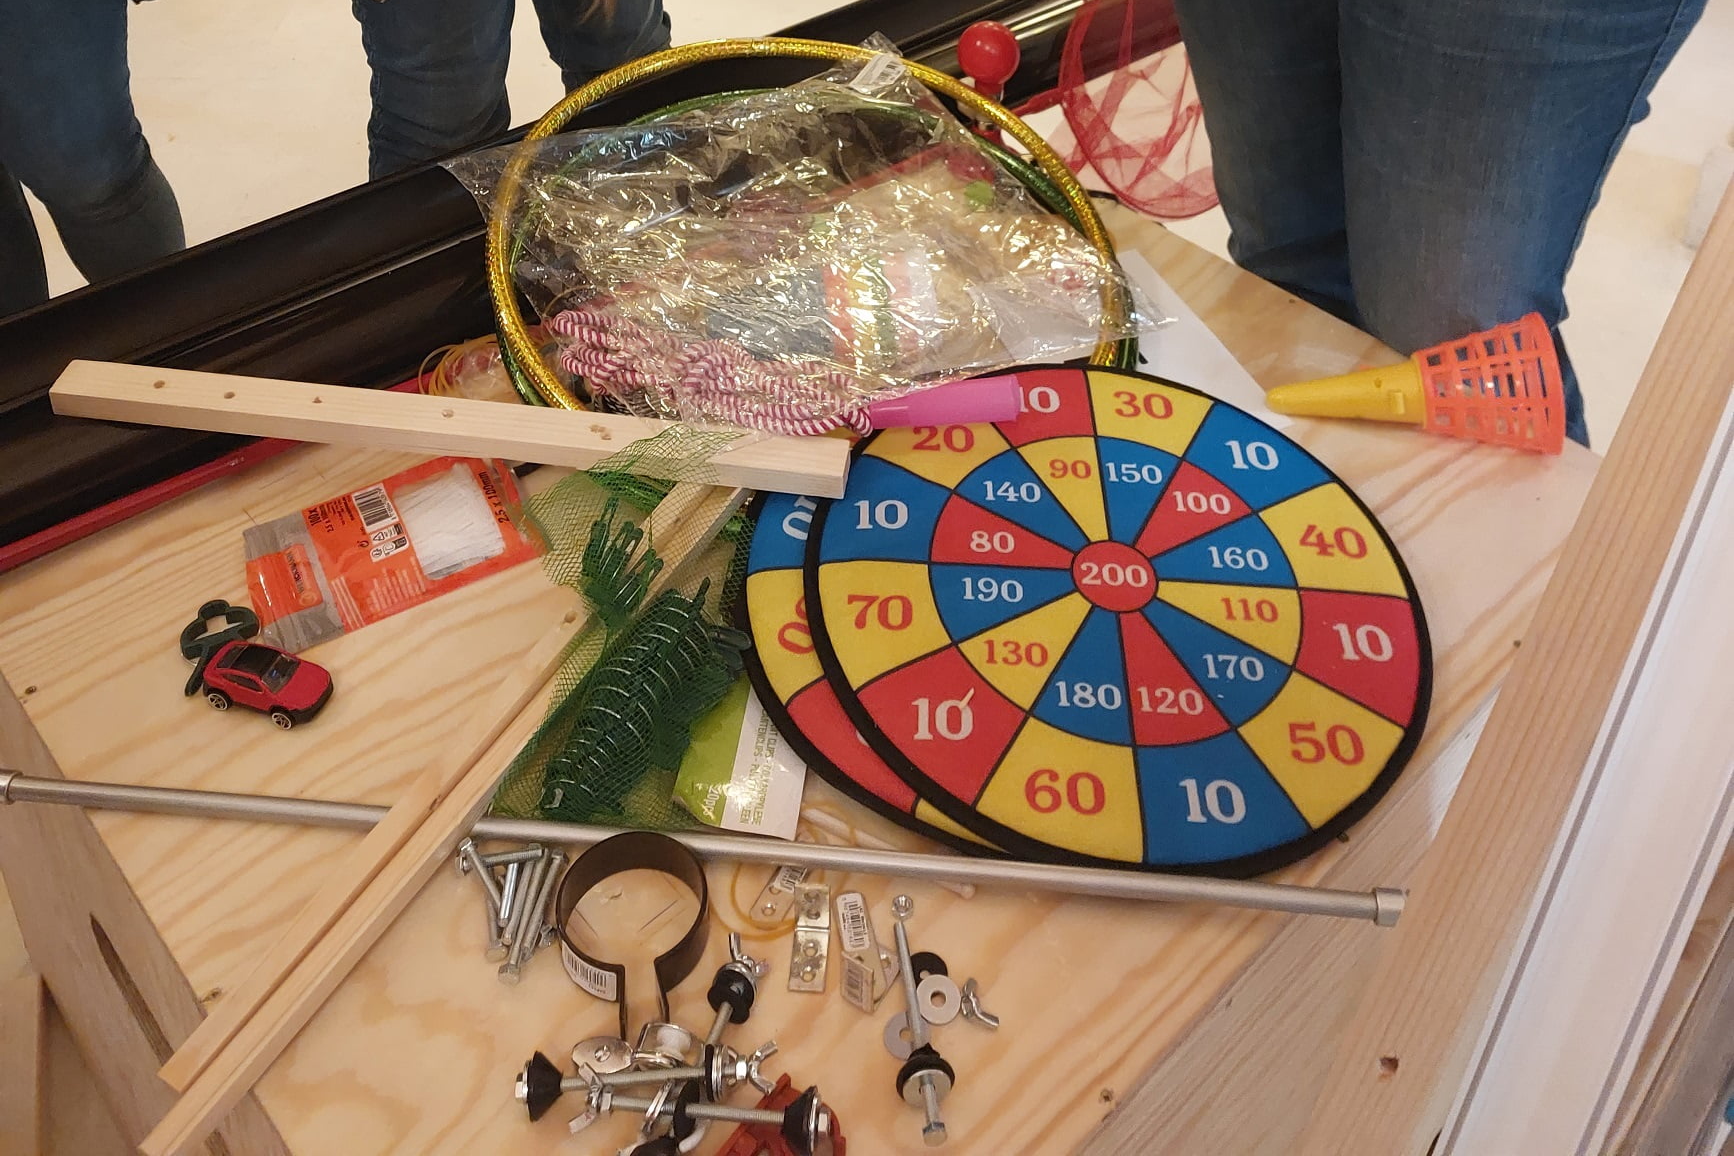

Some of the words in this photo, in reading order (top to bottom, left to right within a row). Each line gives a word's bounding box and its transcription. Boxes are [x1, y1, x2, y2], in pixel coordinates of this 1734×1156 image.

[1115, 393, 1173, 419] 30
[912, 424, 975, 453] 20
[1224, 442, 1279, 470] 10
[1050, 461, 1092, 479] 90
[1107, 464, 1163, 484] 150
[478, 471, 497, 500] 100mm
[983, 482, 1041, 503] 140
[494, 509, 510, 524] 2.5
[856, 501, 908, 529] 10
[1173, 493, 1231, 515] 100
[969, 533, 1015, 553] 80
[1300, 526, 1368, 559] 40
[1209, 548, 1268, 571] 160
[1080, 564, 1148, 587] 200
[962, 579, 1024, 603] 190
[846, 596, 913, 631] 70
[1220, 599, 1279, 623] 110
[984, 641, 1049, 668] 130
[1332, 625, 1393, 661] 10
[1204, 656, 1264, 681] 170
[1056, 683, 1122, 710] 180
[1139, 689, 1204, 714] 120
[913, 698, 973, 740] 10
[765, 737, 777, 759] CLIPS
[1289, 723, 1365, 766] 50
[1025, 770, 1106, 816] 60
[1179, 781, 1246, 823] 10
